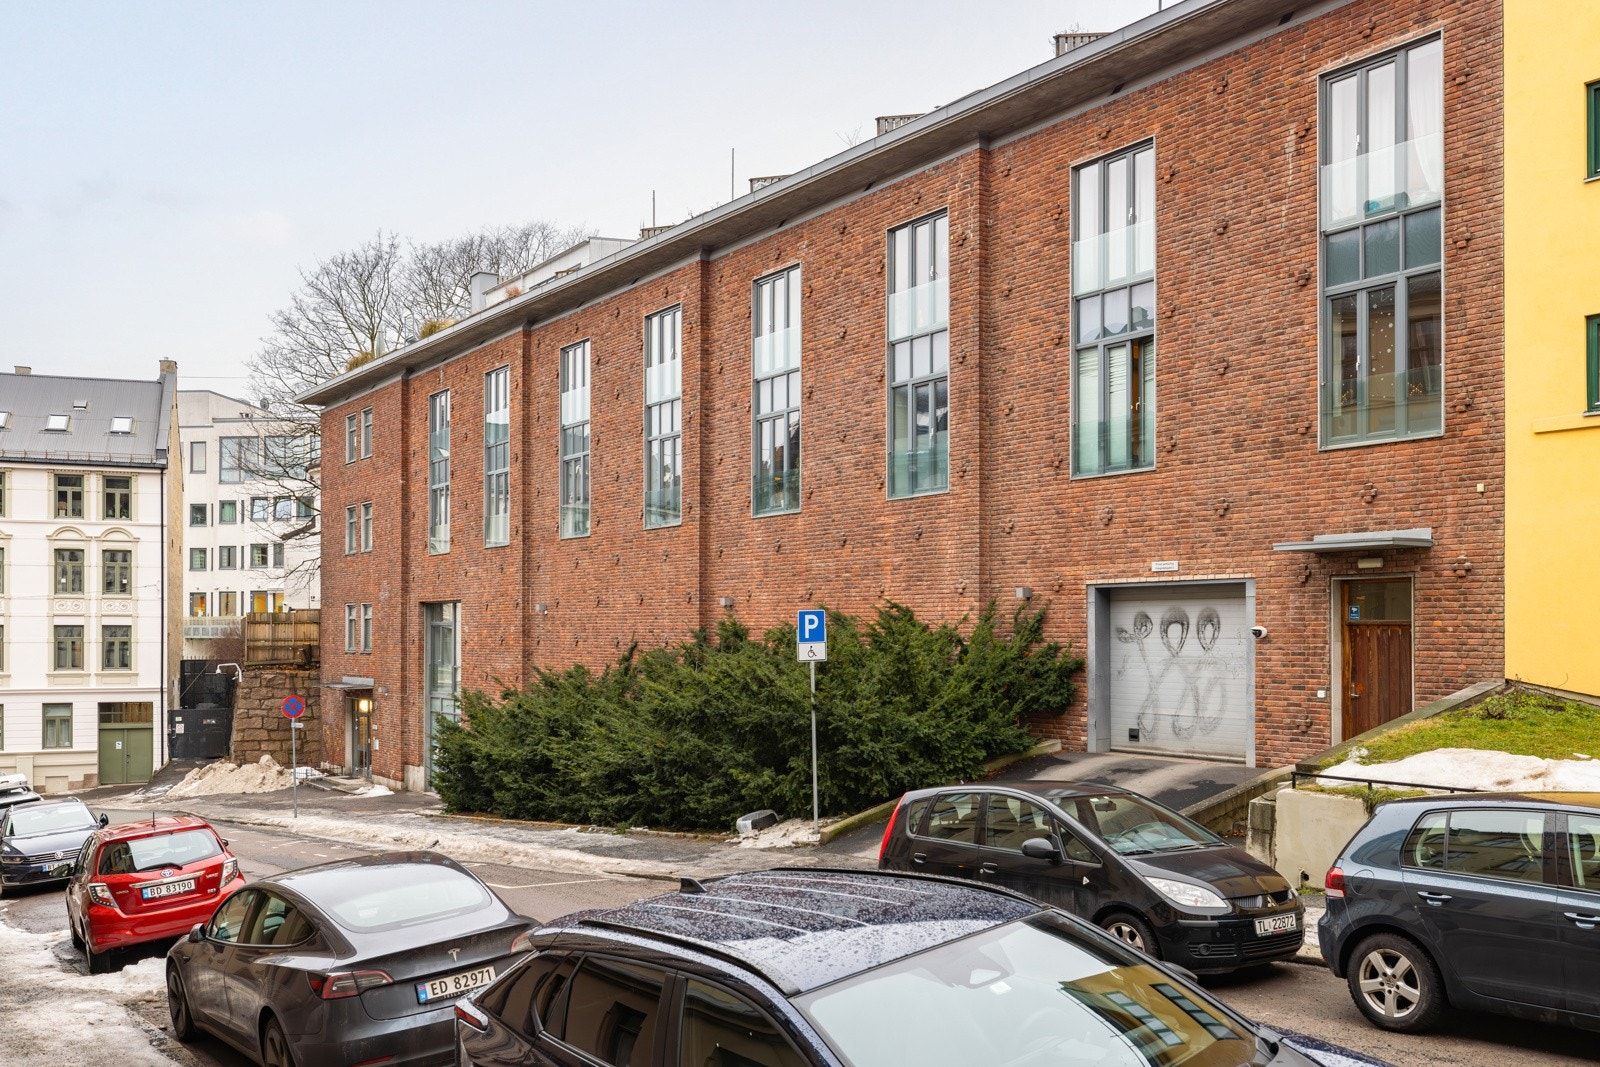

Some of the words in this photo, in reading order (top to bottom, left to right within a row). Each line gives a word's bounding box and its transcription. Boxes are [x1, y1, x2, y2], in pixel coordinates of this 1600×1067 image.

[804, 614, 819, 639] P
[149, 887, 163, 897] BD
[165, 881, 193, 893] 83190
[1257, 920, 1269, 933] TL
[1271, 915, 1295, 930] 22872
[430, 980, 449, 997] ED
[453, 968, 492, 990] 82971
